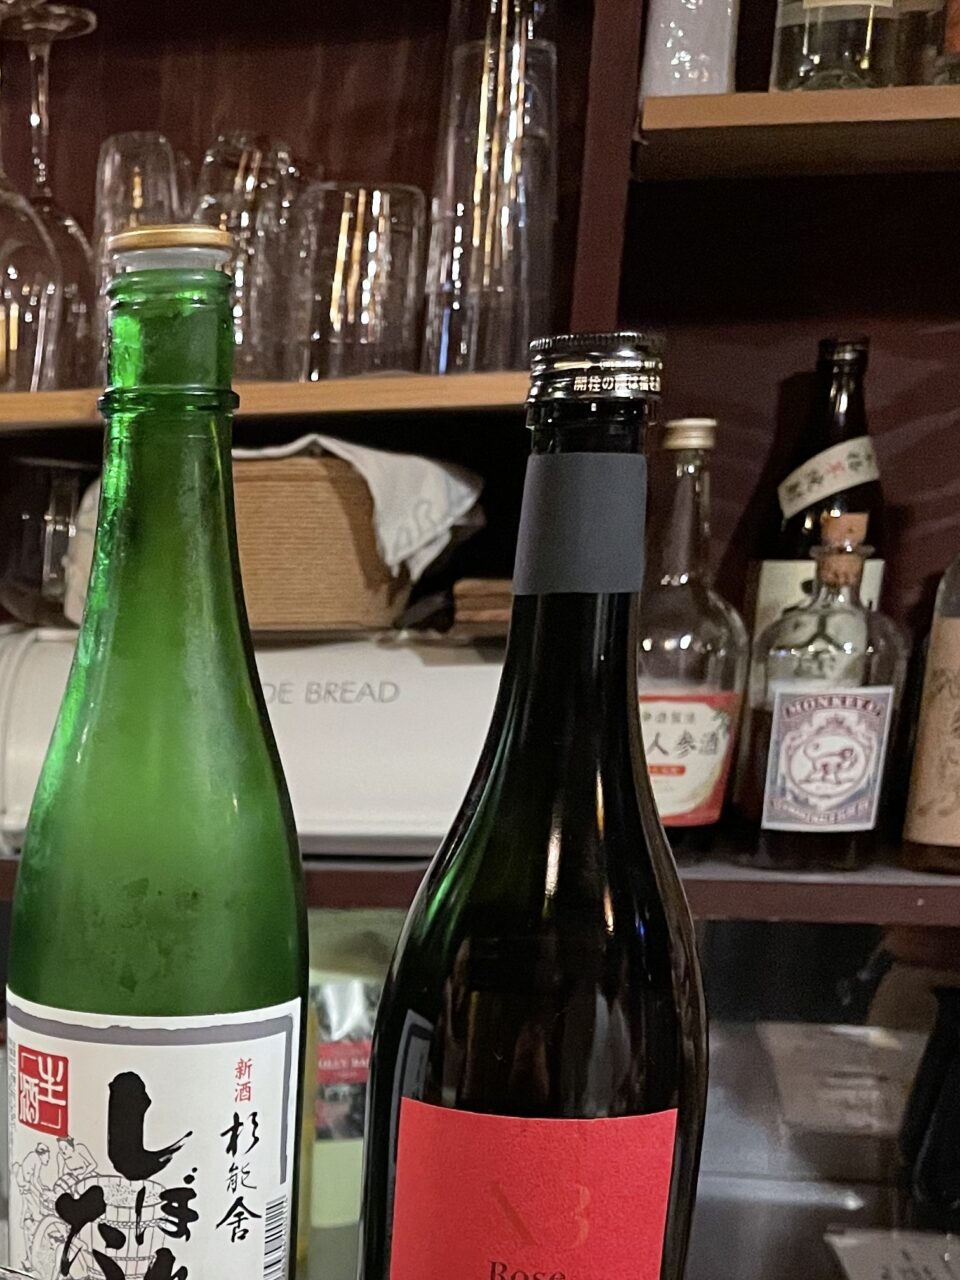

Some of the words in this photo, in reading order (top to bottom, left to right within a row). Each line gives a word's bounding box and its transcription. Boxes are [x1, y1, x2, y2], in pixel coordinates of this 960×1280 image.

[304, 681, 401, 704] BREAD
[233, 1057, 253, 1103] 新酒
[215, 1111, 263, 1243] 杉能舎
